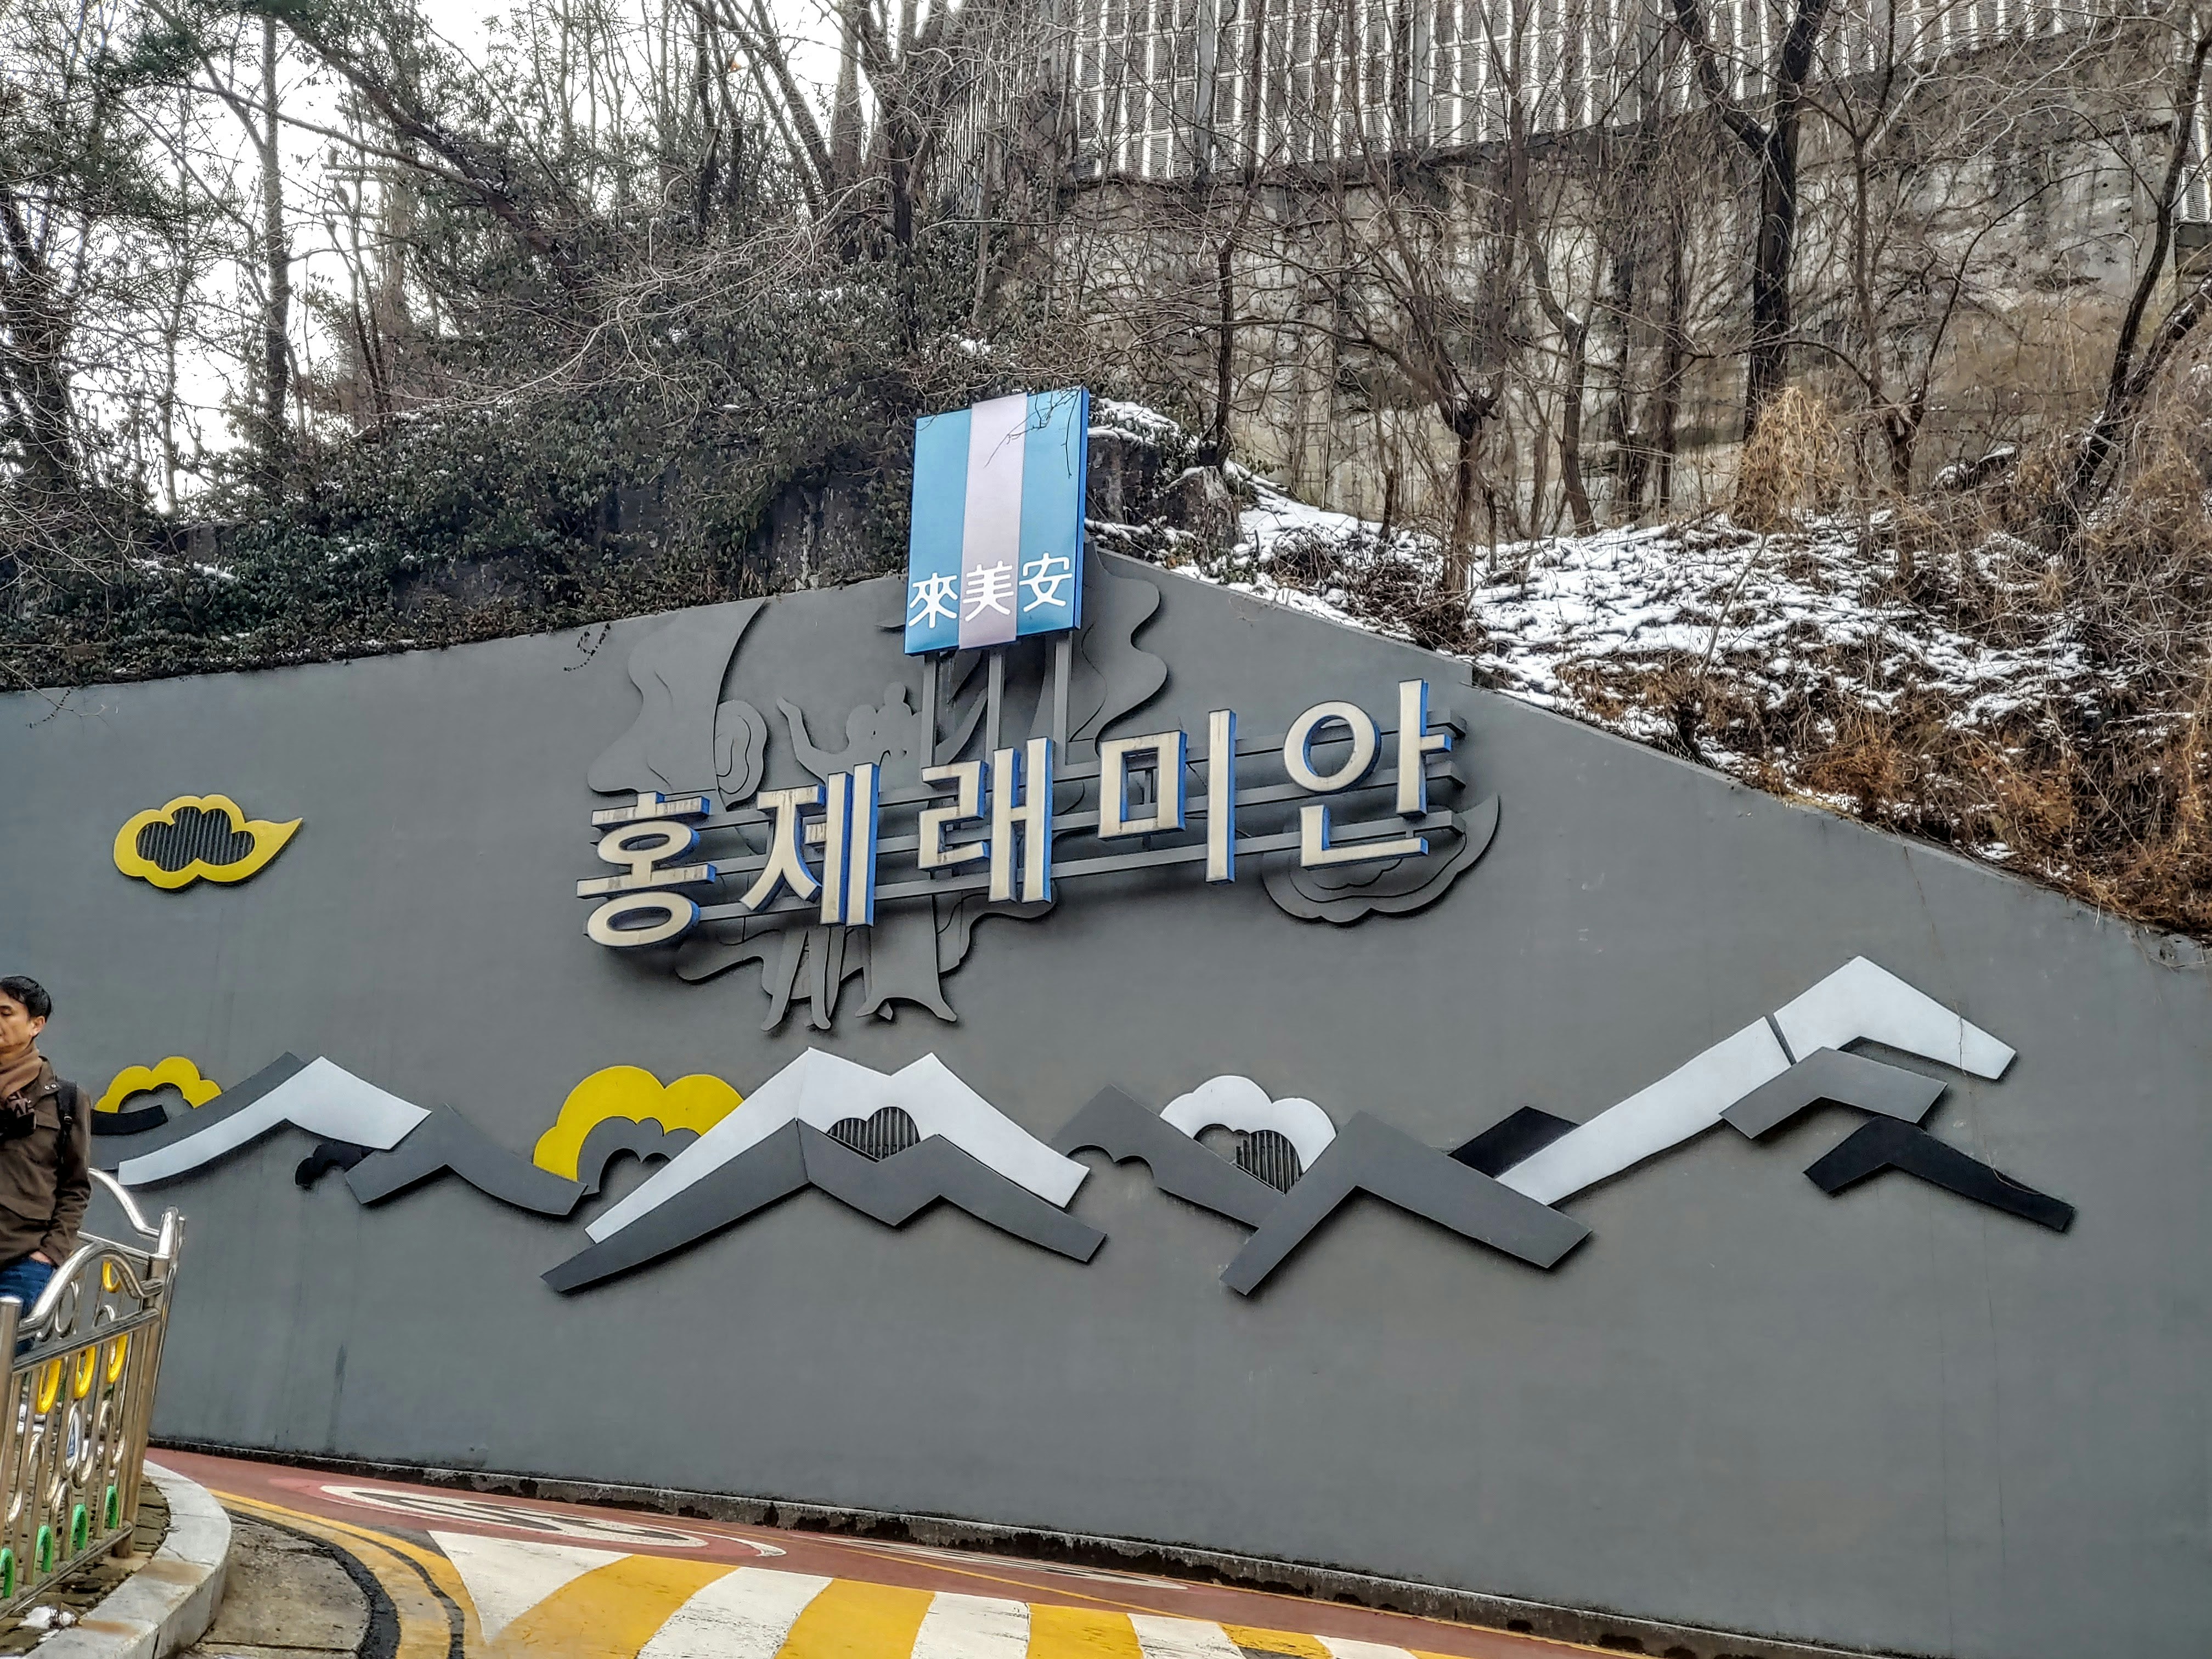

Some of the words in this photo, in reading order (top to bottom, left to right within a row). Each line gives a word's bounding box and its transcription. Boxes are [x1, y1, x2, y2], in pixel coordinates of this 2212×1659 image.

[908, 552, 1073, 629] 來美安
[576, 678, 1452, 947] 홍제래미안
